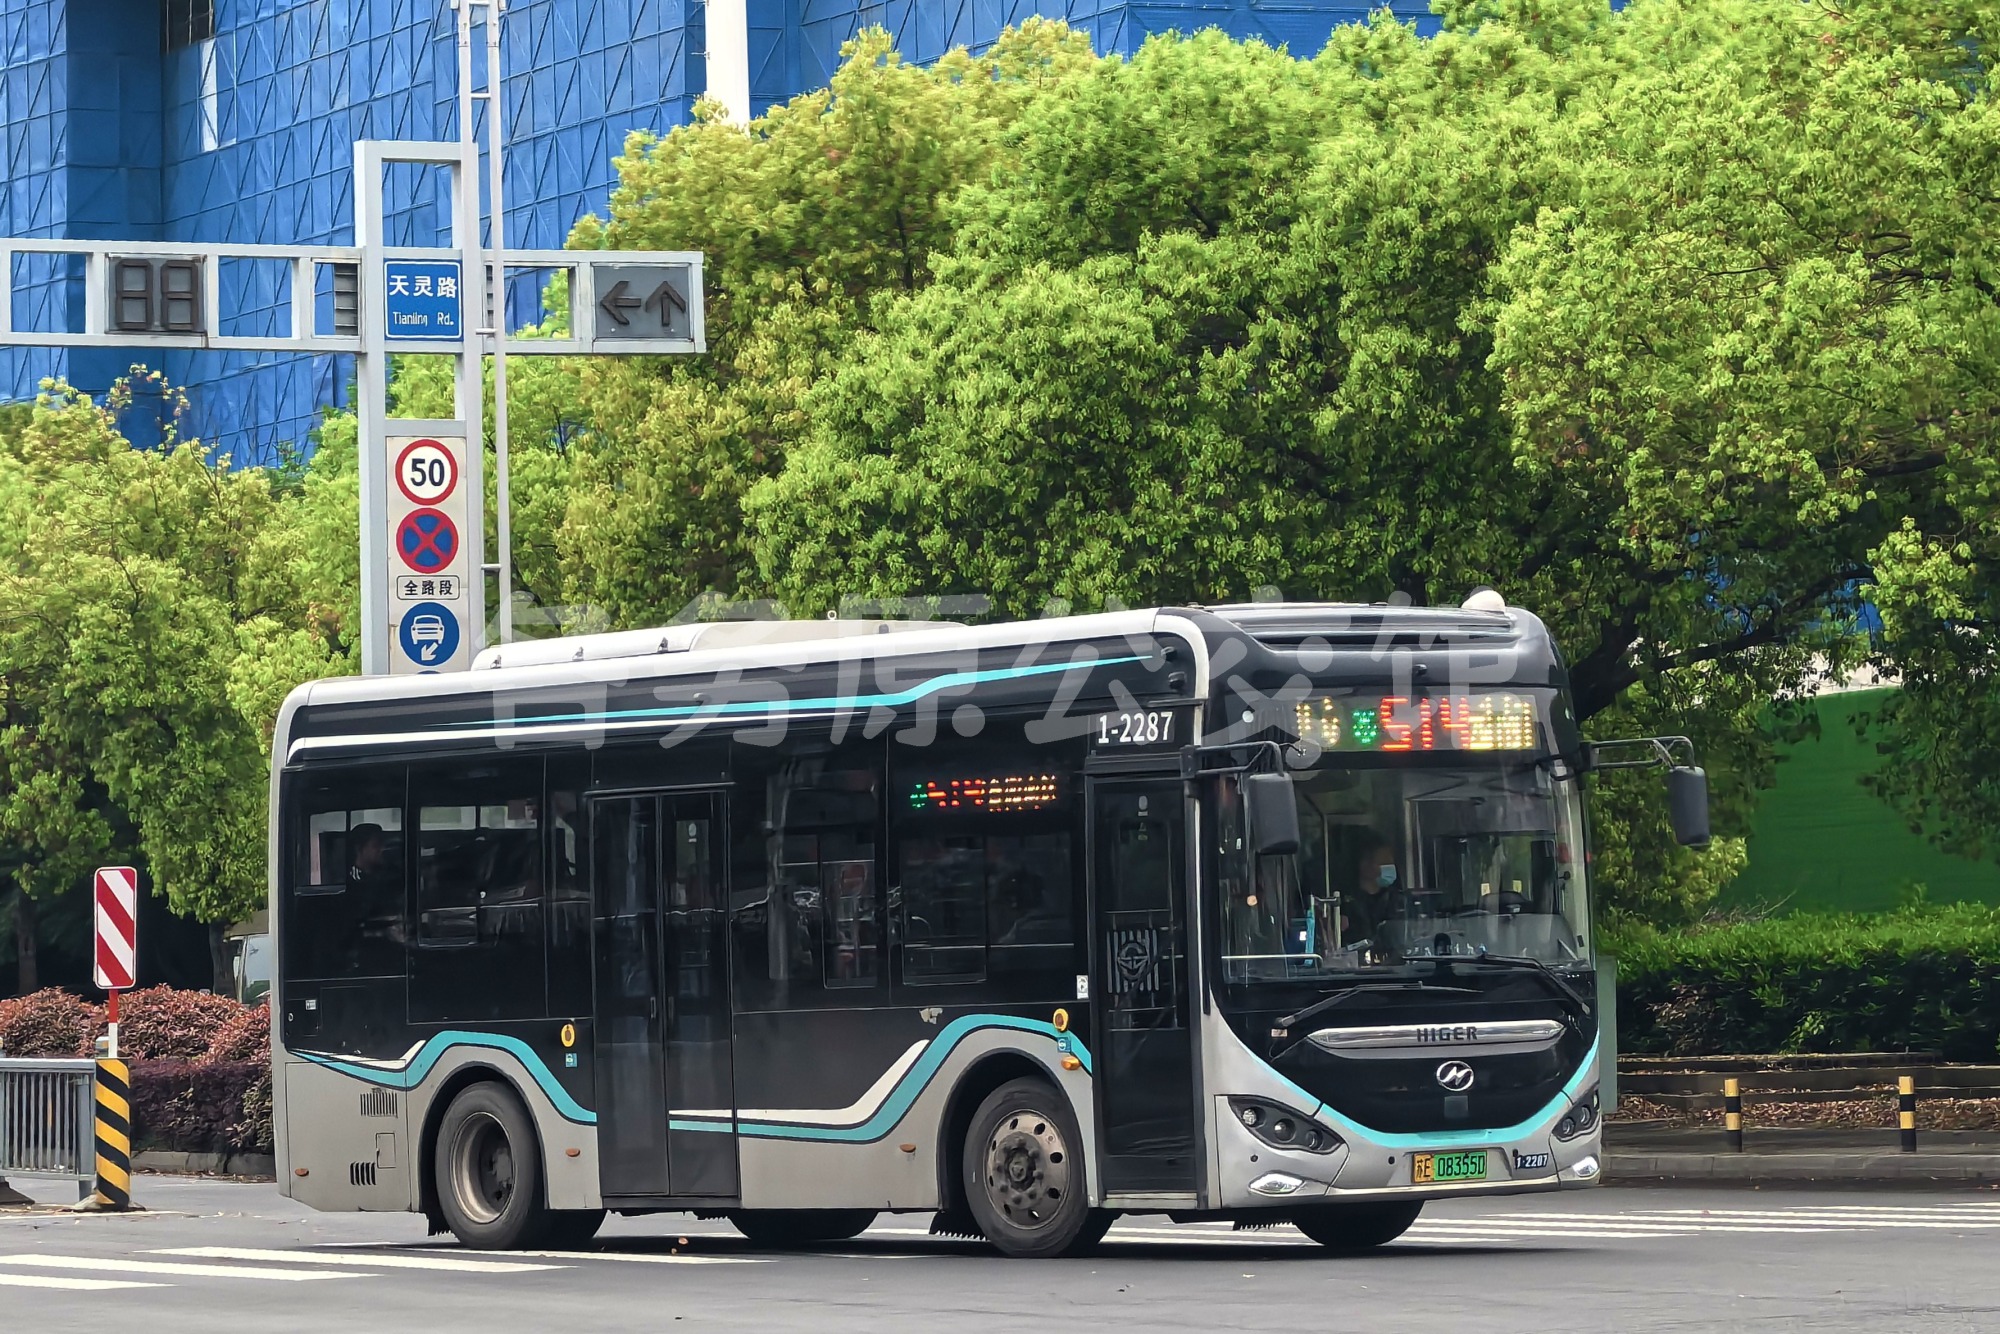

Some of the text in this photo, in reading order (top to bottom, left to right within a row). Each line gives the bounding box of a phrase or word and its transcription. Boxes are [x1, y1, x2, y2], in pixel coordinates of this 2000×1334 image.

[389, 275, 457, 298] 天灵路
[393, 311, 455, 327] Tianling Rd.
[410, 458, 445, 487] 50
[404, 580, 453, 596] 全路段
[1098, 711, 1173, 744] 1-2287
[1379, 697, 1470, 751] 514
[1417, 1026, 1478, 1042] HIGER
